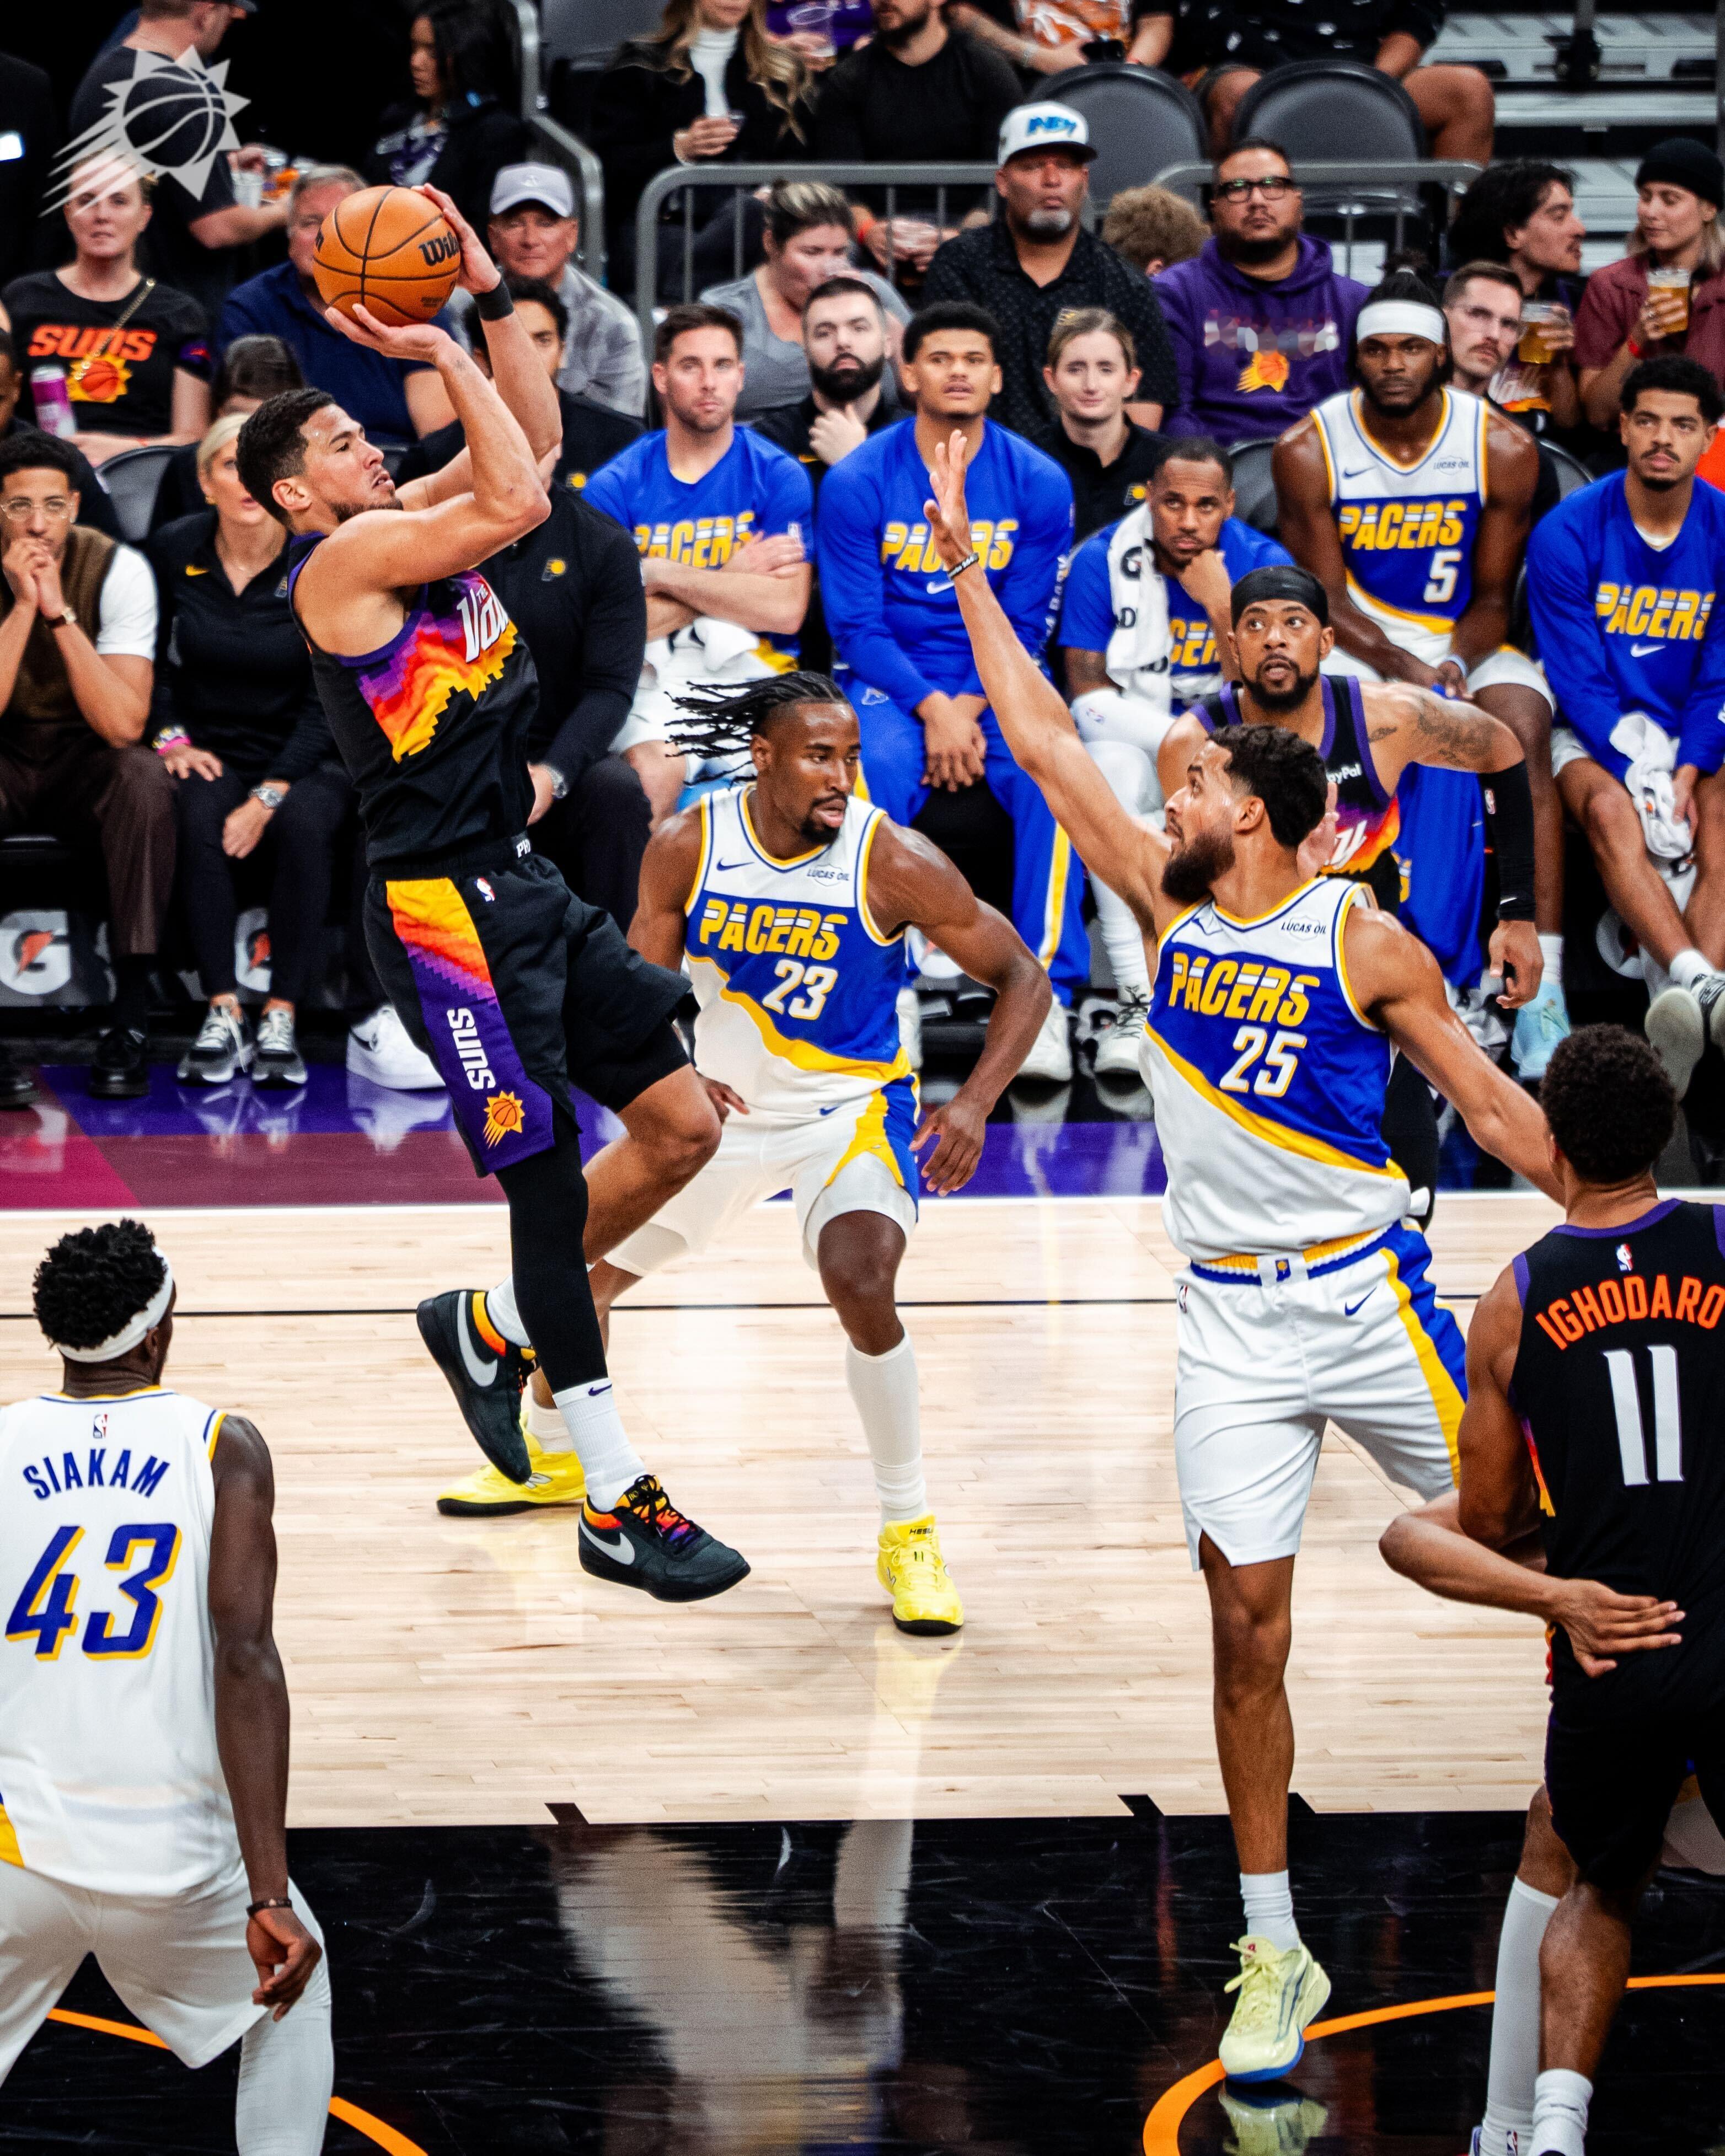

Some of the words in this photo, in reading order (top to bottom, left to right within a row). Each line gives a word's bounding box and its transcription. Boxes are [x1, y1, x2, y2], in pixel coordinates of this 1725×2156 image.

[28, 324, 158, 362] SUNS
[1433, 462, 1456, 470] LUCAS
[1339, 500, 1467, 550] PACERS
[1423, 550, 1462, 603] 5
[1326, 762, 1363, 785] ayPal
[807, 869, 835, 879] LUCAS
[837, 872, 850, 881] OIL
[699, 898, 849, 961] PACERS
[1281, 921, 1312, 934] LUCAS
[1313, 924, 1327, 935] OIL
[762, 958, 839, 1020] 23
[1168, 952, 1321, 1027] PACERS
[446, 1007, 496, 1090] SUNS
[1219, 1026, 1308, 1098] 25
[1535, 1274, 1725, 1351] IGHODARO
[1602, 1343, 1685, 1487] 11
[22, 1448, 170, 1501] SIAKAM
[5, 1522, 183, 1662] 43
